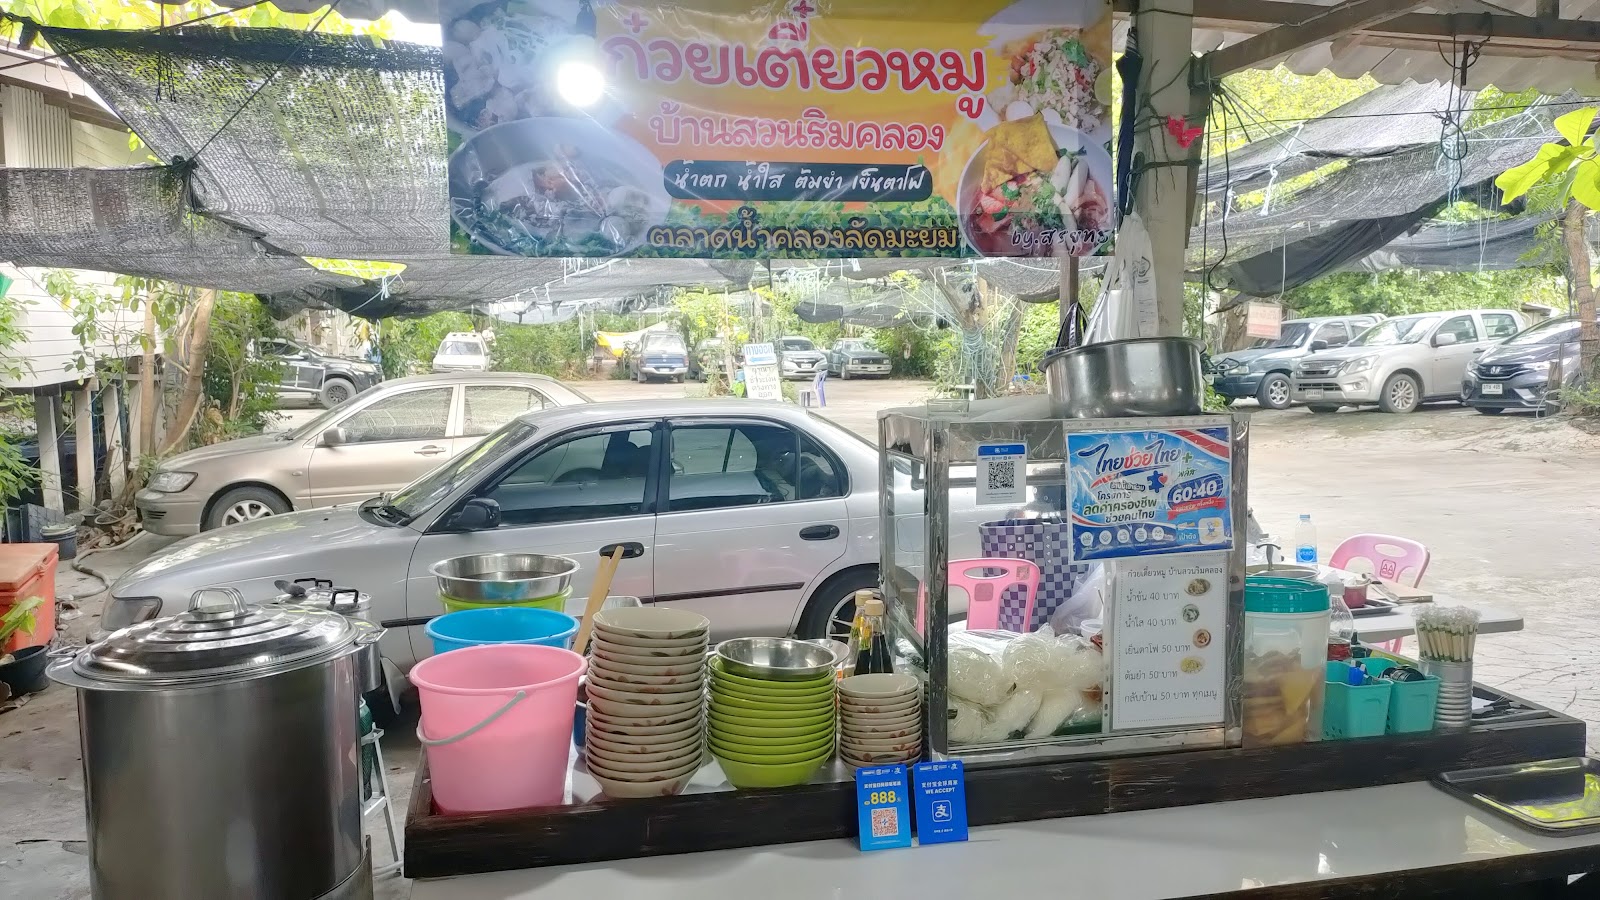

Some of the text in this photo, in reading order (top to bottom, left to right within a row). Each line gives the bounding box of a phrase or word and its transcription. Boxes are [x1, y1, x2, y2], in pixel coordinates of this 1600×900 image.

[602, 1, 985, 119] ก๋วยเตี๋ยวหมู
[650, 101, 945, 151] บ้านสวนริมคลอง
[674, 159, 925, 192] น้ำตก น้ำใส ต้มยำ เย็นตาโฟ
[649, 209, 957, 249] ตลาดน้ำคลองลัดมะยม
[1077, 439, 1181, 475] ไทยช่วยไทย
[1172, 480, 1218, 504] 60:40
[1084, 496, 1157, 515] ลดค่าครองชีพ
[1105, 510, 1155, 523] ช่วยคนไทย
[1150, 592, 1160, 601] 40
[1162, 592, 1180, 600] บาท
[1147, 618, 1158, 627] 40
[1161, 618, 1177, 626] บาท
[1161, 645, 1172, 653] 50
[1175, 644, 1191, 652] บาท
[1148, 671, 1159, 679] 50
[1162, 671, 1178, 679] บาท
[1160, 692, 1171, 700] 50
[1173, 691, 1190, 699] บาท
[870, 790, 896, 805] 888
